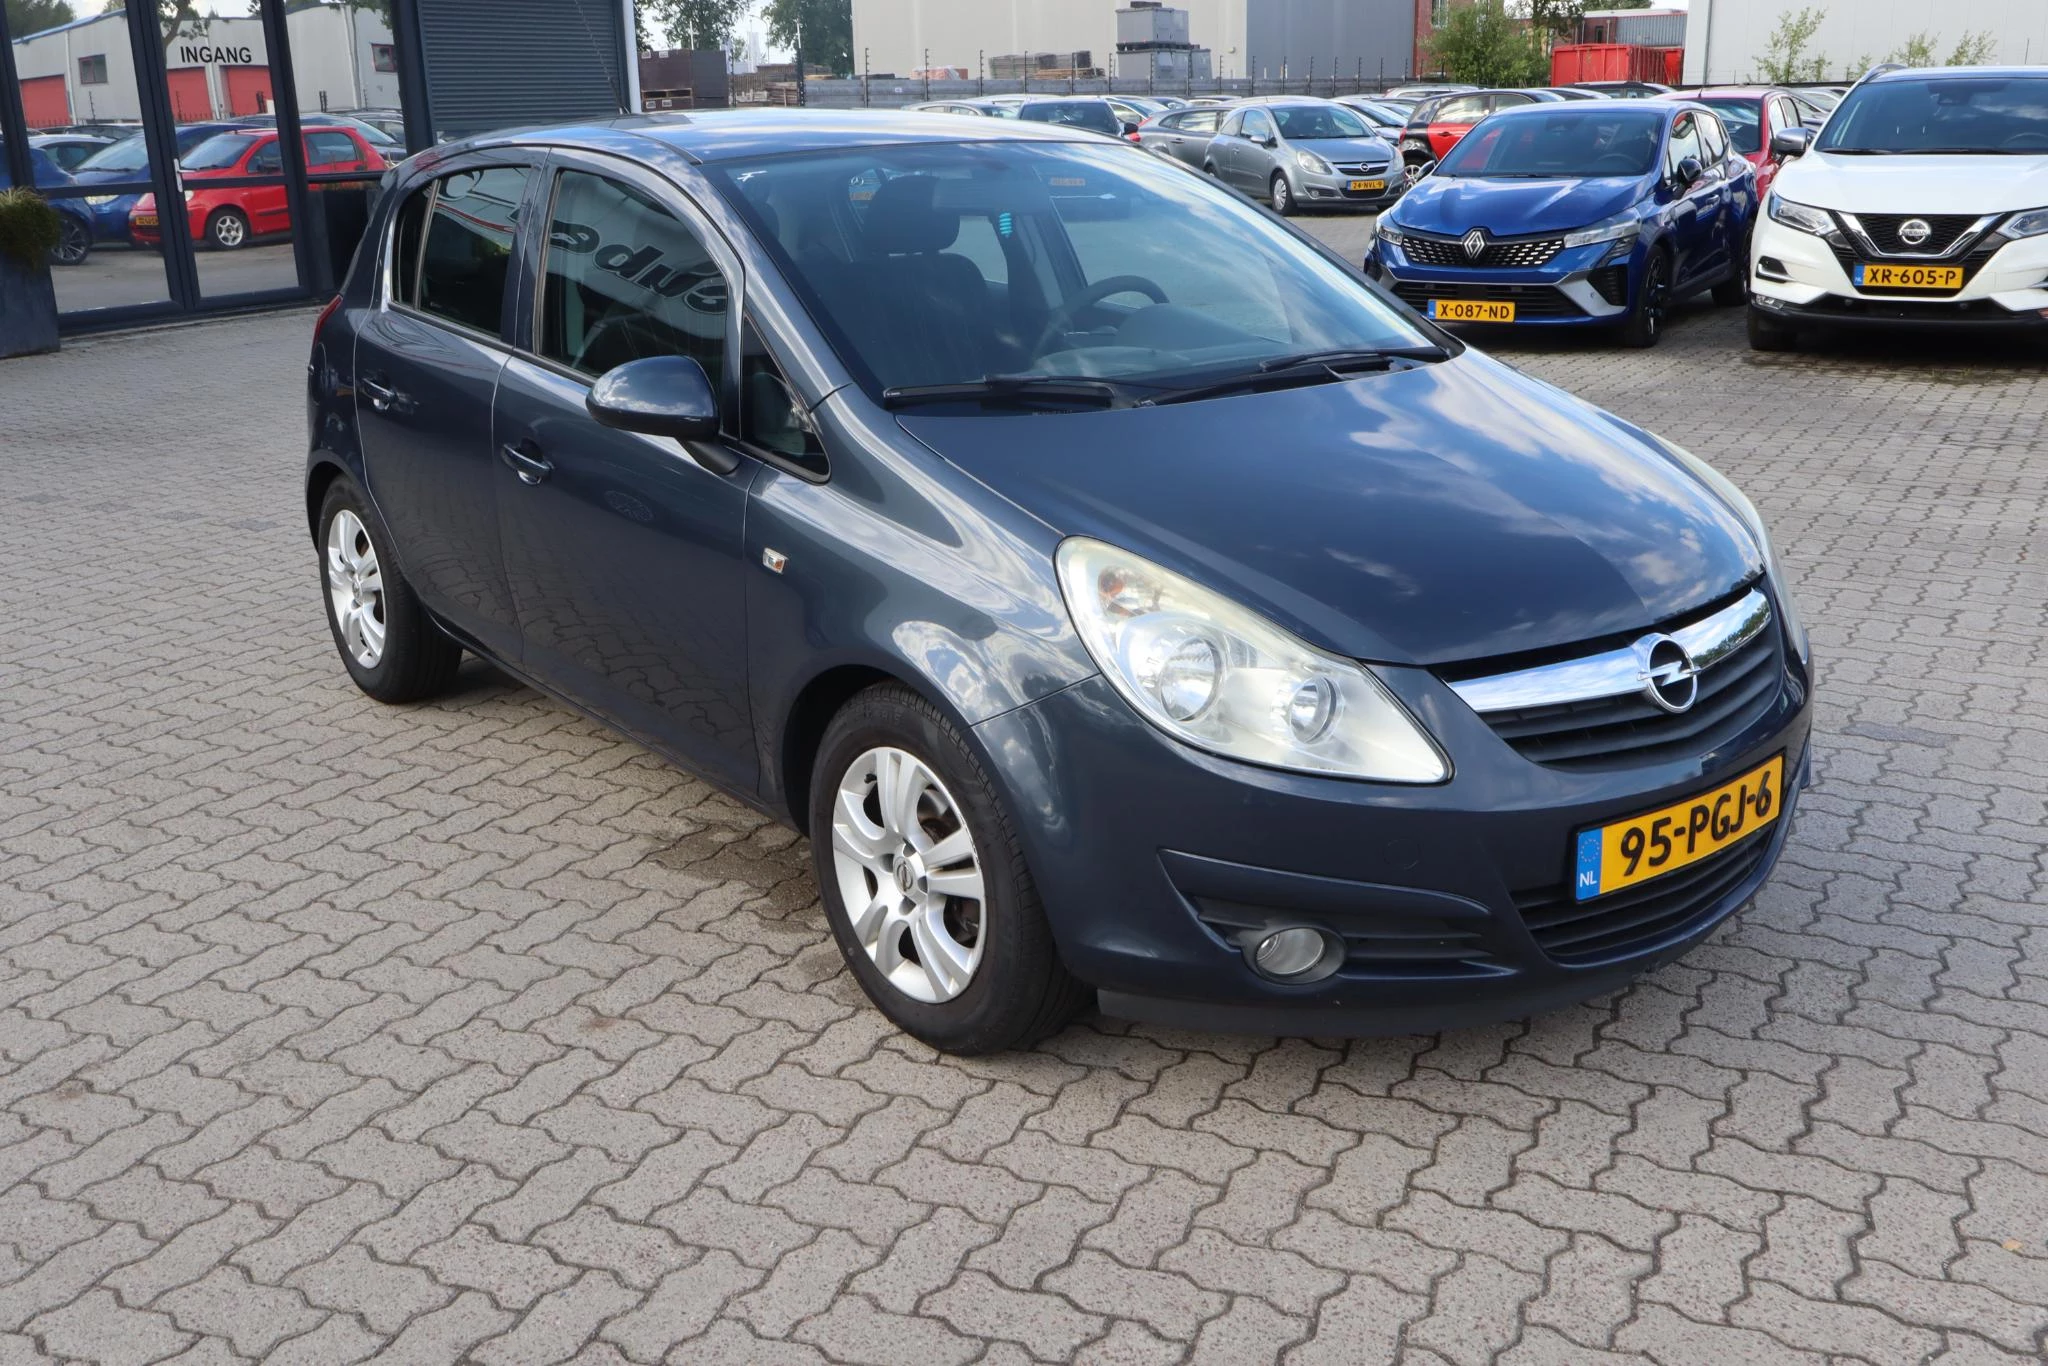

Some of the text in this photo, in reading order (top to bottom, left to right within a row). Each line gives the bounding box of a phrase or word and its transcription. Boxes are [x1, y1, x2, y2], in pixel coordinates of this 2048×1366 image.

[180, 46, 252, 64] INGANG
[1352, 180, 1383, 190] 24-NVL-9
[1868, 267, 1956, 285] XR-605-P
[1440, 303, 1510, 319] X-087-ND
[1620, 770, 1772, 877] 95-PGJ-6
[1579, 871, 1598, 888] NL
